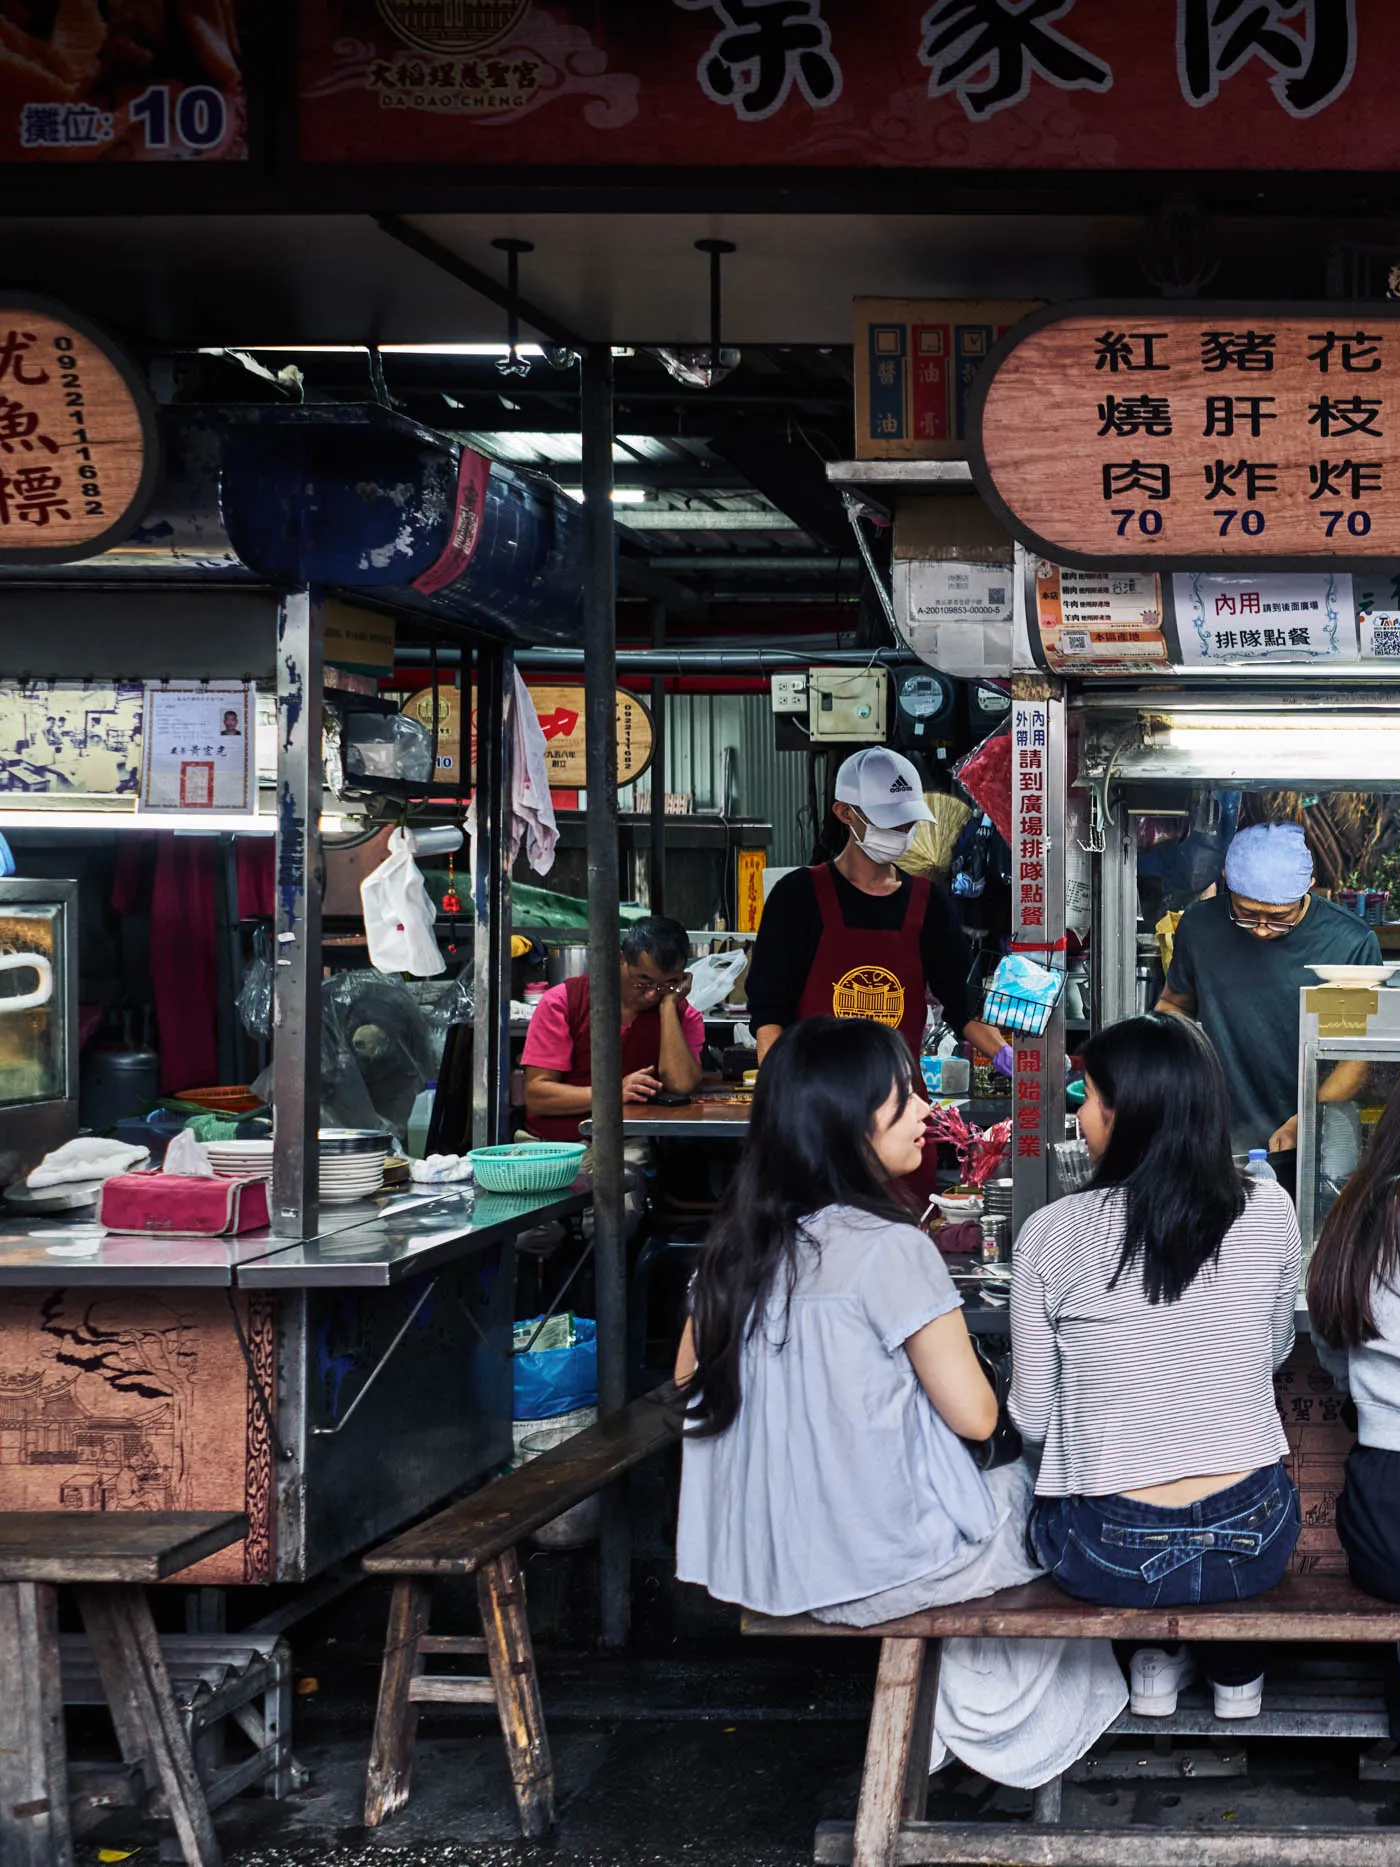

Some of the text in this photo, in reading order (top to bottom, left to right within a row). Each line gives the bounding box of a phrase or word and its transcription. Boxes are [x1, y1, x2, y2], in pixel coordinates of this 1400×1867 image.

[131, 87, 226, 148] 10
[382, 95, 524, 107] DA DAO CHENG
[54, 336, 104, 515] 0922111682
[1094, 331, 1173, 501] 紅燒肉
[1200, 330, 1279, 501] 豬肝炸
[1307, 331, 1384, 501] 花枝炸
[1111, 509, 1164, 537] 70
[1213, 510, 1266, 537] 70
[1319, 510, 1372, 538] 70
[1214, 627, 1312, 650] 排隊點餐
[1016, 710, 1028, 747] 外帶
[544, 751, 576, 759] 九五八年
[1019, 749, 1044, 926] 請到廣場排隊點餐
[1017, 1050, 1041, 1158] 開始營業
